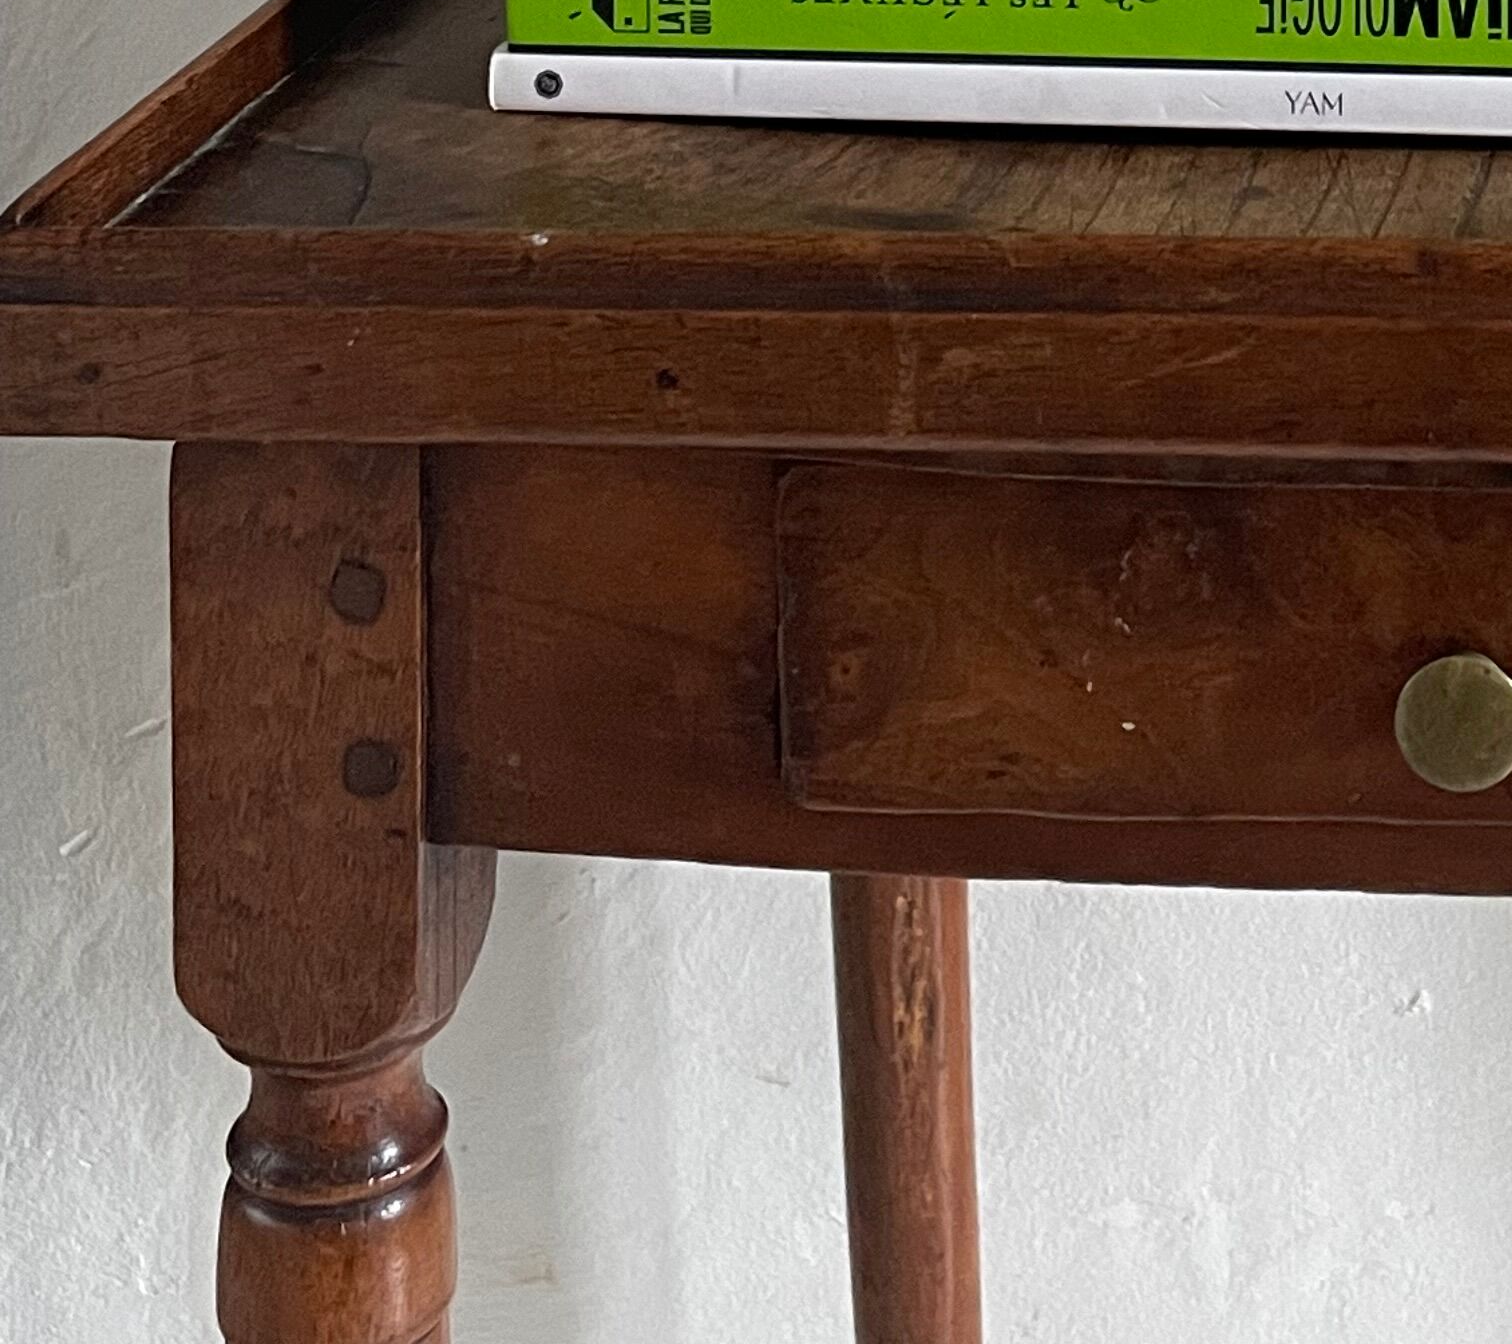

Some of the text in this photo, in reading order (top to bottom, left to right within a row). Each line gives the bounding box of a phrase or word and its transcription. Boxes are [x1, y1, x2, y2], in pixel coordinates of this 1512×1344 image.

[658, 12, 685, 34] LA
[689, 9, 713, 35] QUI
[1285, 91, 1342, 116] YAM
